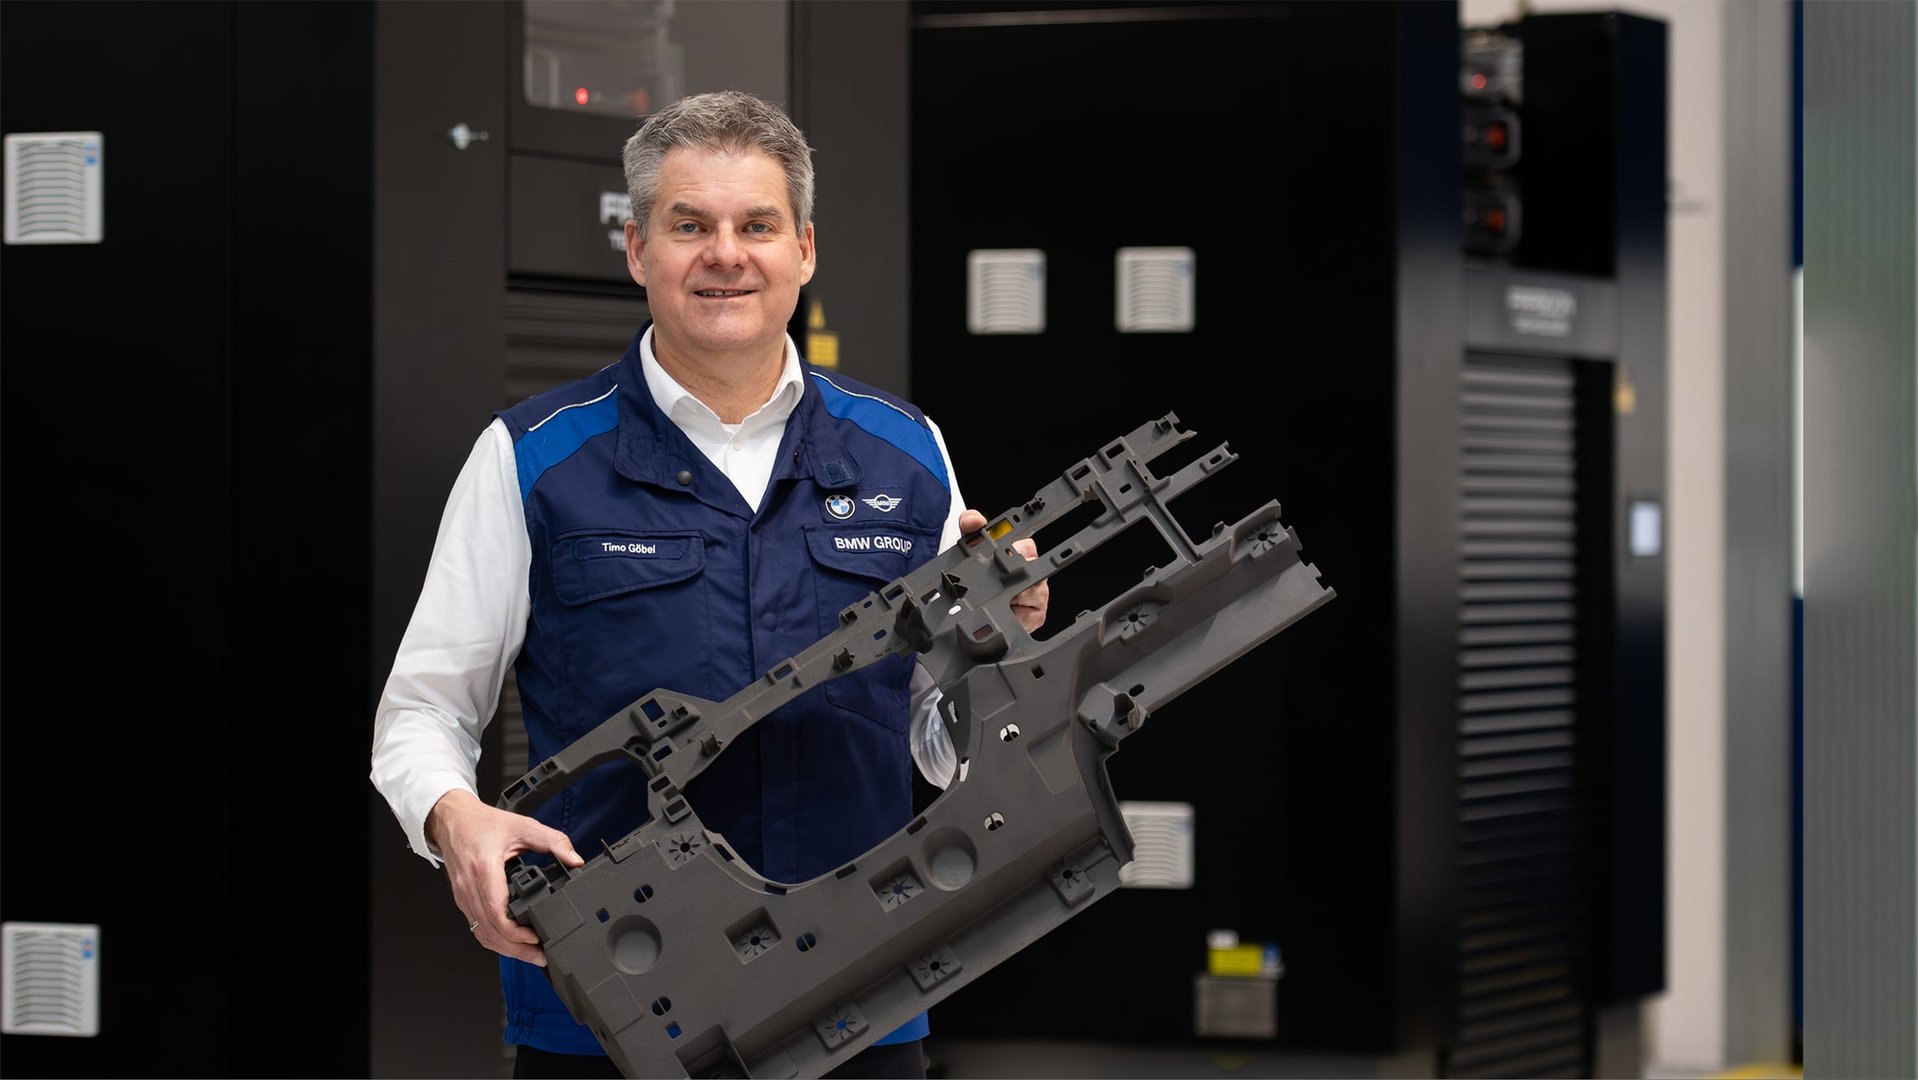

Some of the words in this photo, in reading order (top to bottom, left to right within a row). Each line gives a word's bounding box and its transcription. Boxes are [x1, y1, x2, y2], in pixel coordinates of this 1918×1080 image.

[601, 542, 627, 552] Timo
[628, 543, 656, 554] Göbel
[834, 537, 870, 550] BMW
[873, 536, 912, 553] GROUP
